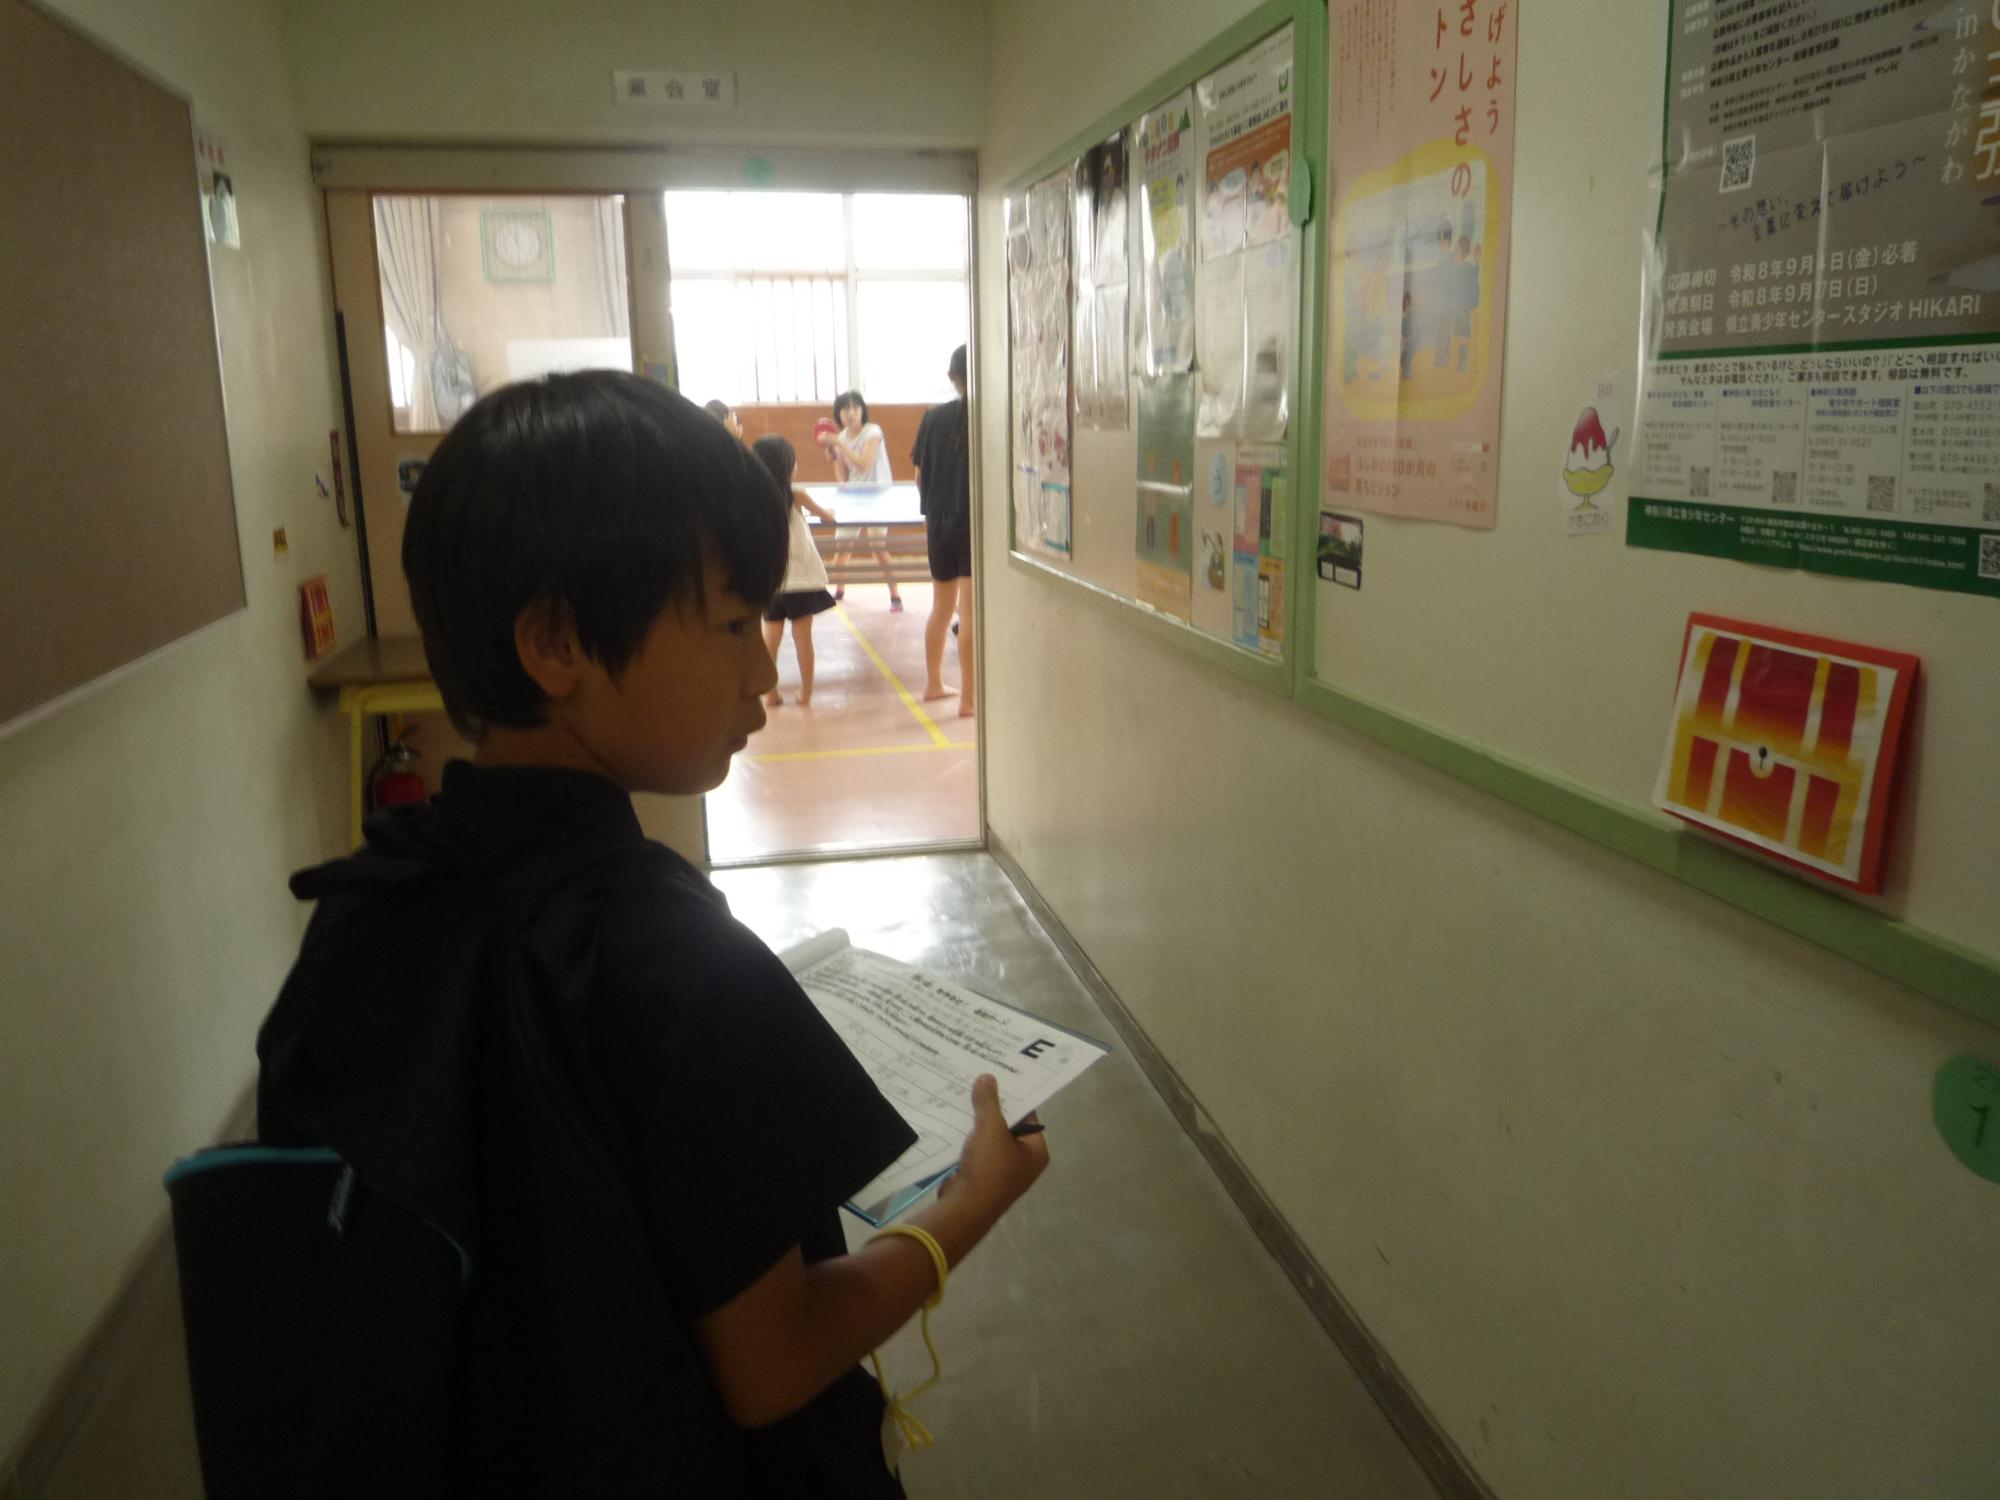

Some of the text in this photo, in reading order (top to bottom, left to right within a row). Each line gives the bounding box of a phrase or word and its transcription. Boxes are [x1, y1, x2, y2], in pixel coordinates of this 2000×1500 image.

[1430, 8, 1447, 102] トン
[1730, 241, 1918, 284] 令和8年9月日(金)必着
[1019, 1038, 1057, 1060] E
